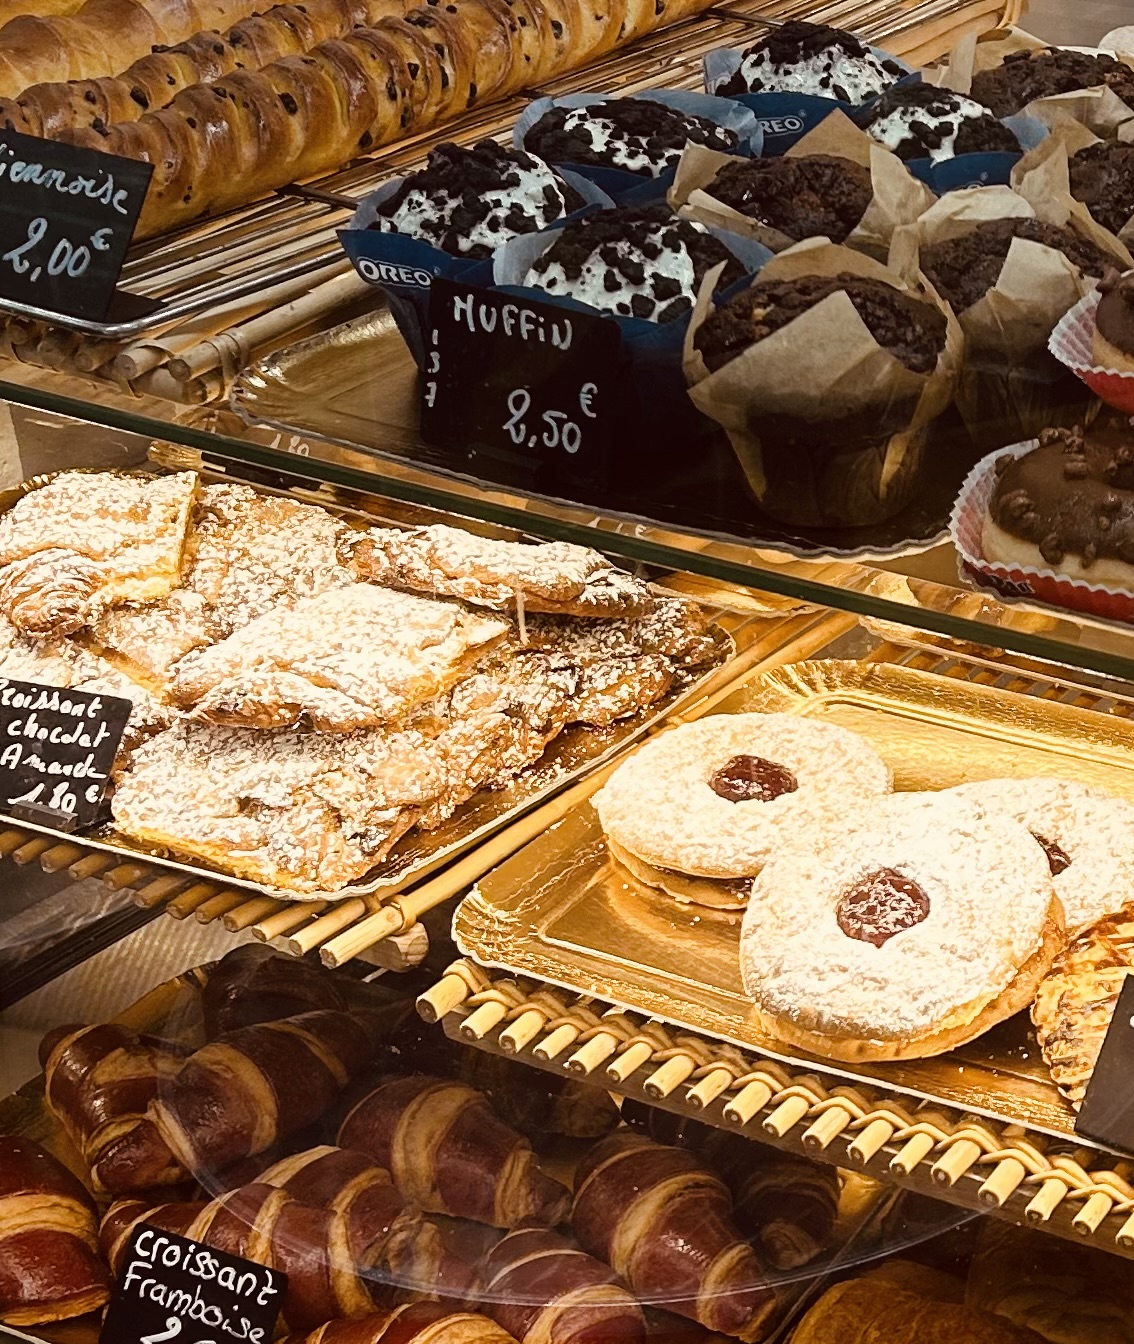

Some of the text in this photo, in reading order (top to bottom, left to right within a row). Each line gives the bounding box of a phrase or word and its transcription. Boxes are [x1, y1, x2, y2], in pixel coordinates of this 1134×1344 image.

[758, 117, 802, 134] REO
[0, 143, 129, 216] iennoise
[358, 259, 432, 287] OREO
[7, 712, 111, 748] chocolat
[0, 742, 108, 779] Amande
